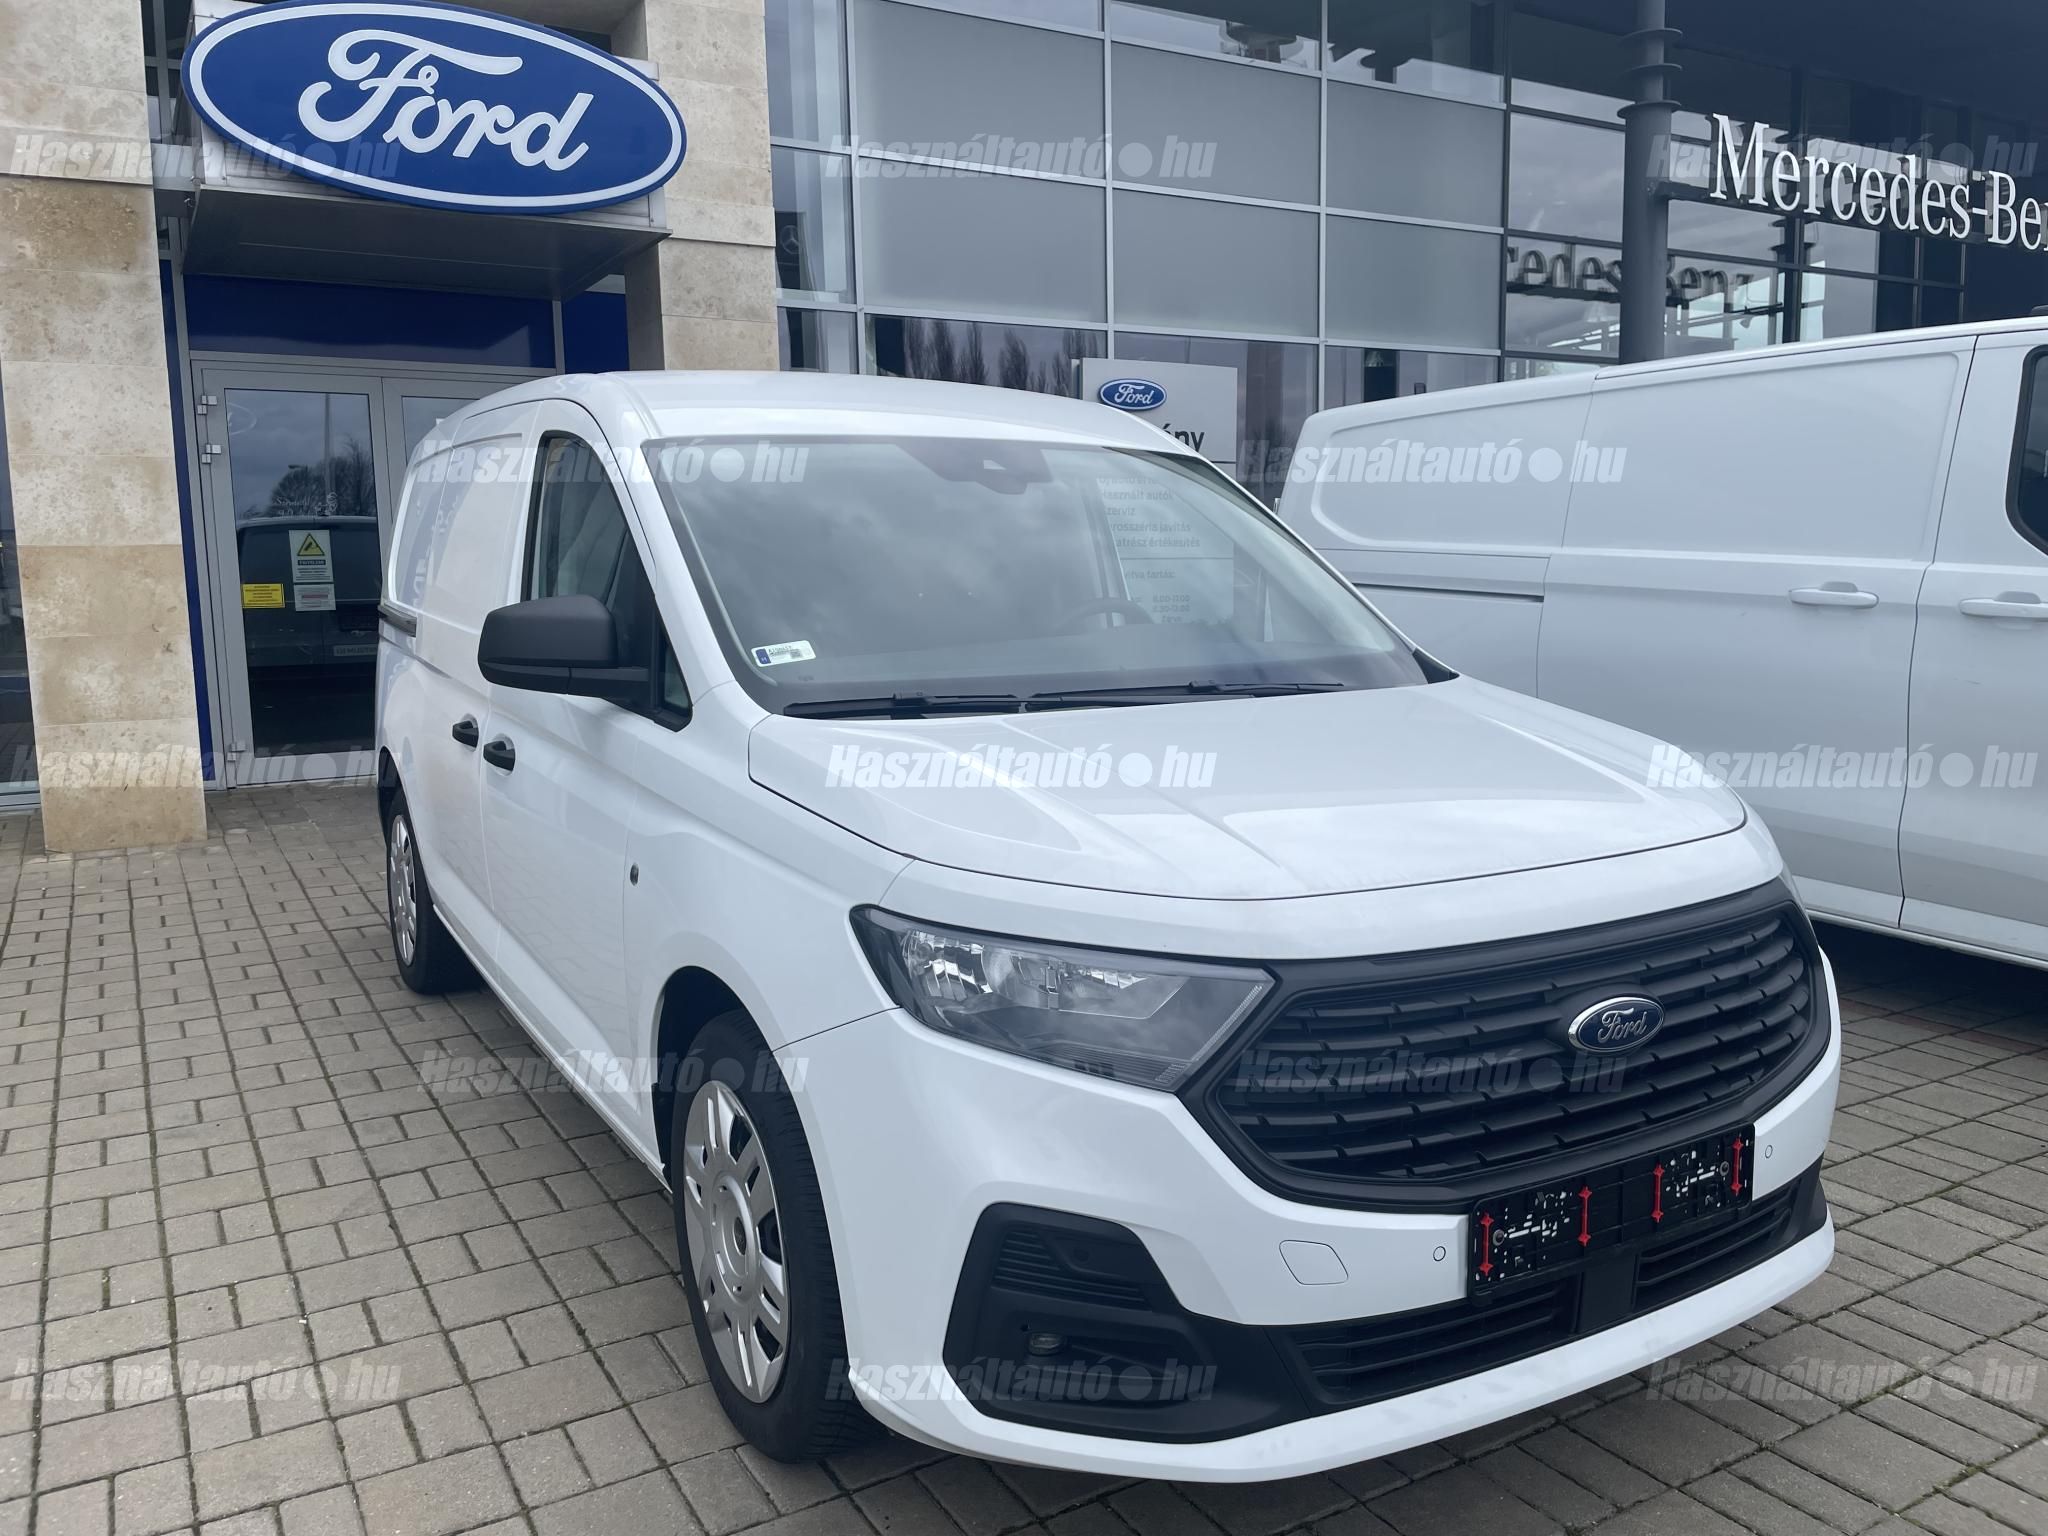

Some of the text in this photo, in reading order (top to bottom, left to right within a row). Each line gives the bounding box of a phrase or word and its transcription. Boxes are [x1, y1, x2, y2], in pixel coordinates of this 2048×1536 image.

[298, 29, 594, 171] Ford
[1710, 112, 2048, 251] Mercedes-Be
[1114, 383, 1154, 405] Ford
[1597, 1007, 1648, 1043] Ford
